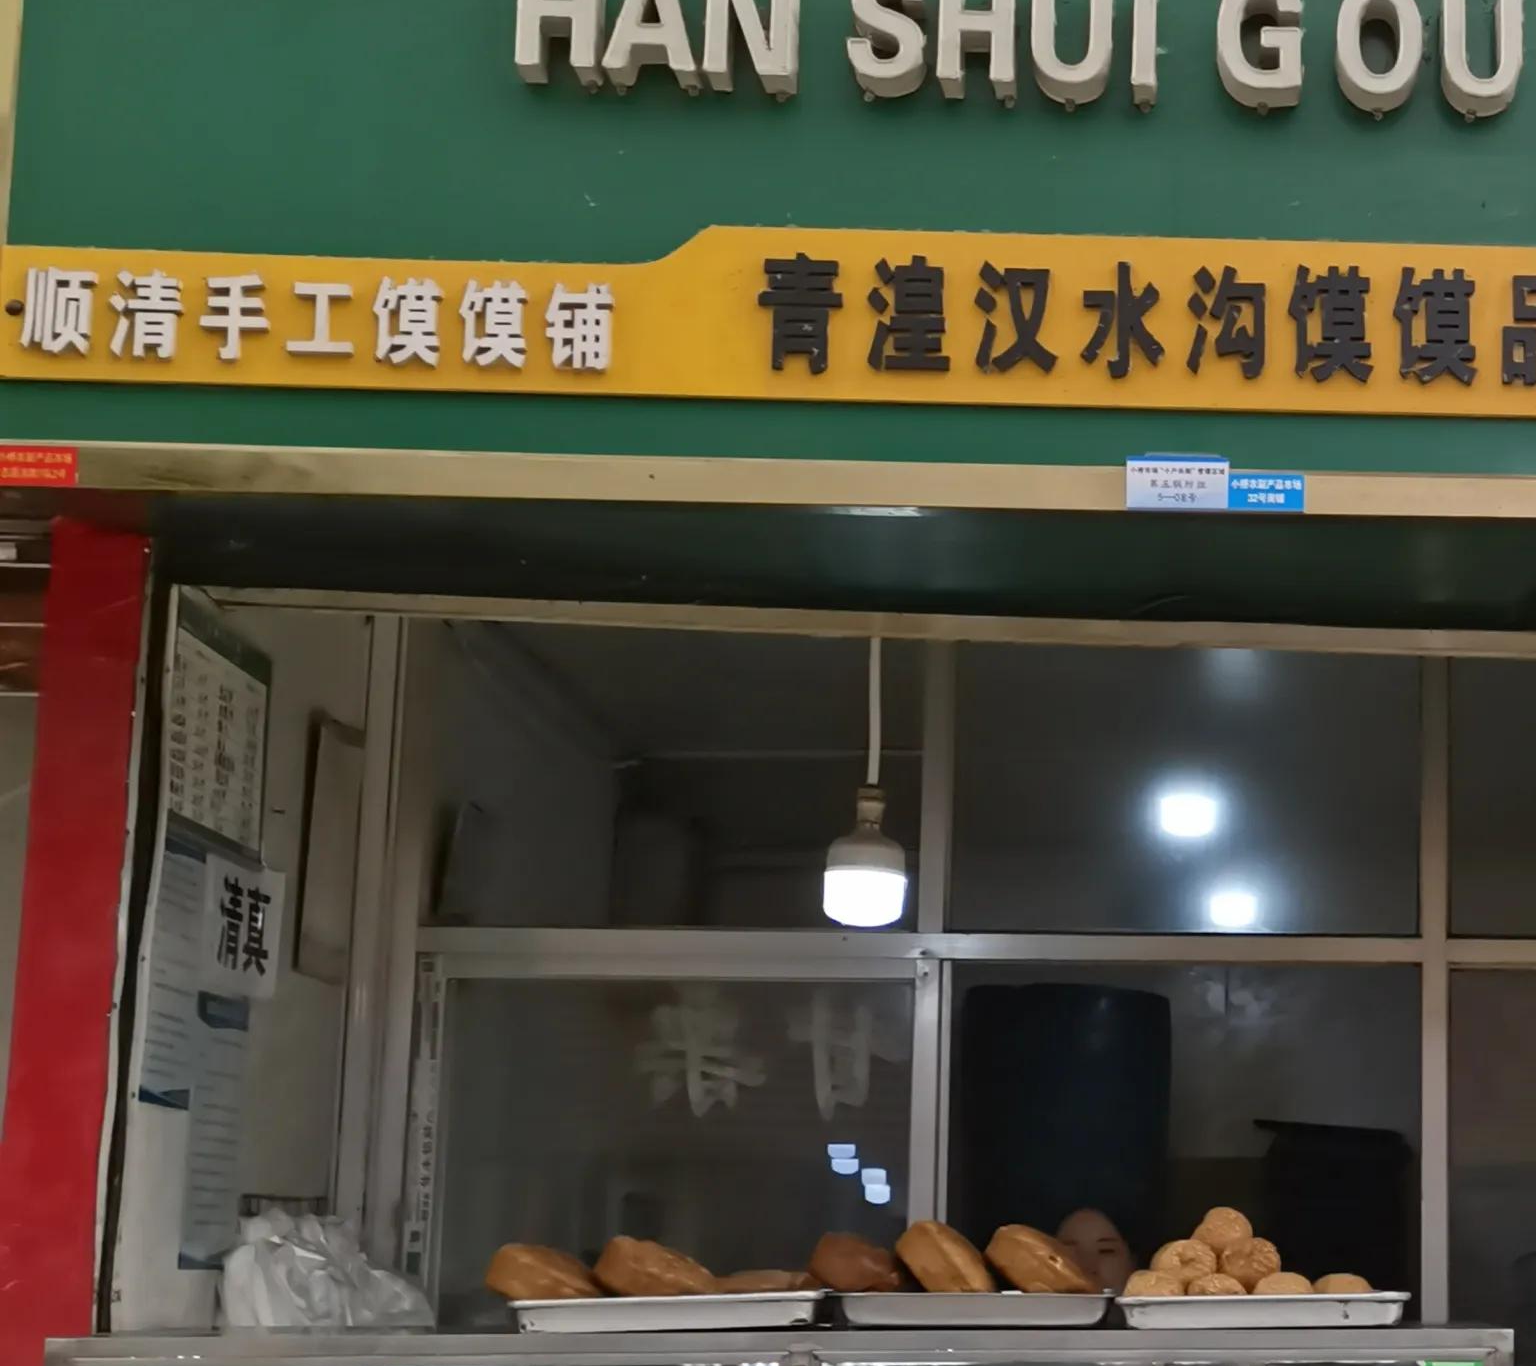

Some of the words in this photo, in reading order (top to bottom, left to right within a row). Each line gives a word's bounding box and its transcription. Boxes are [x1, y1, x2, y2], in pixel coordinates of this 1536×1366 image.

[20, 265, 615, 372] 顺清手工馍馍铺
